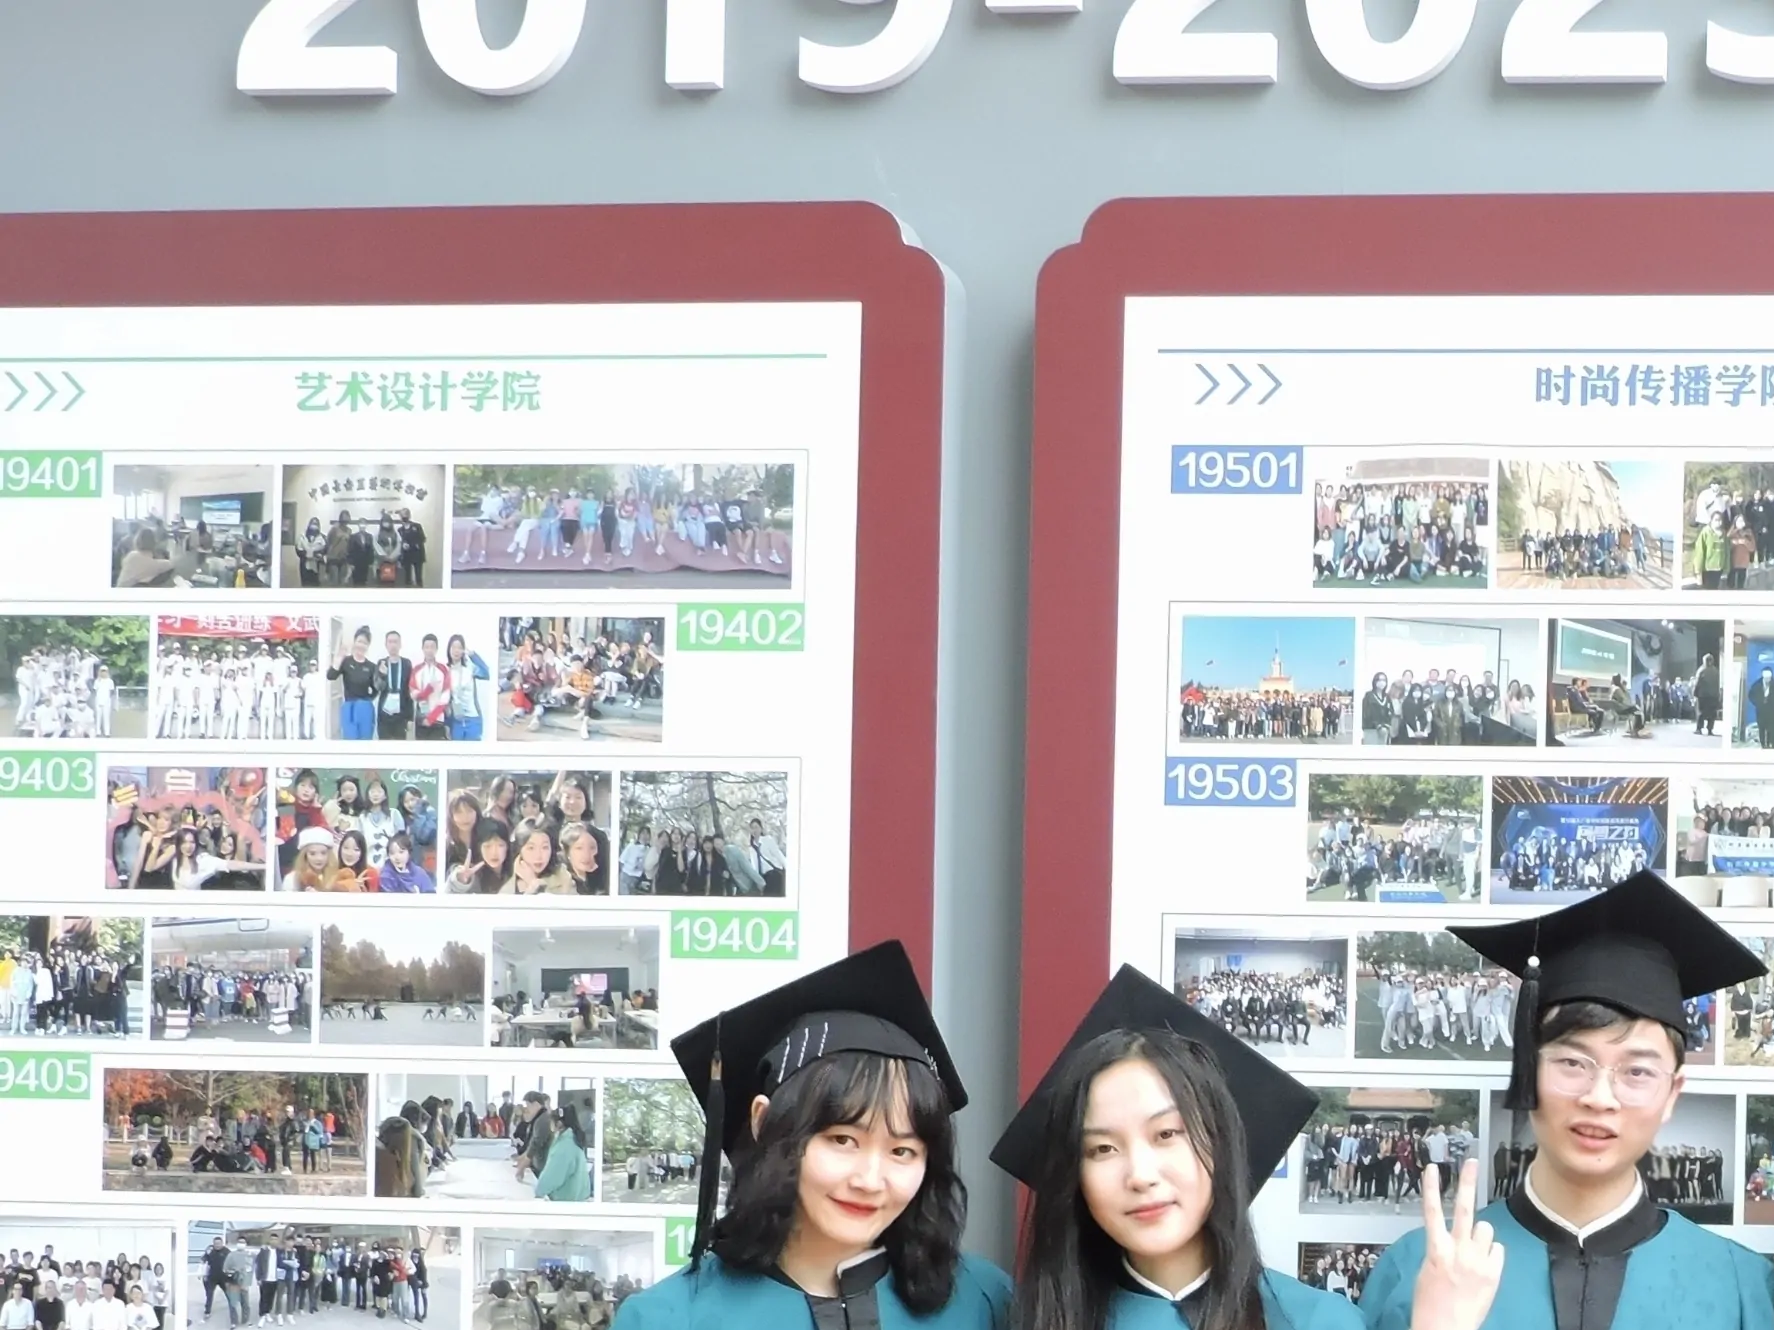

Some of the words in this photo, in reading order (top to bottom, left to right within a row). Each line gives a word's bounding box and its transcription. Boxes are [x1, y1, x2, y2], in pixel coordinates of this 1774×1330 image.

[295, 371, 541, 413] 艺术设计学院
[1178, 450, 1301, 488] 19501
[680, 609, 802, 646] 19402
[1168, 762, 1295, 801] 19503
[672, 917, 797, 954] 19404
